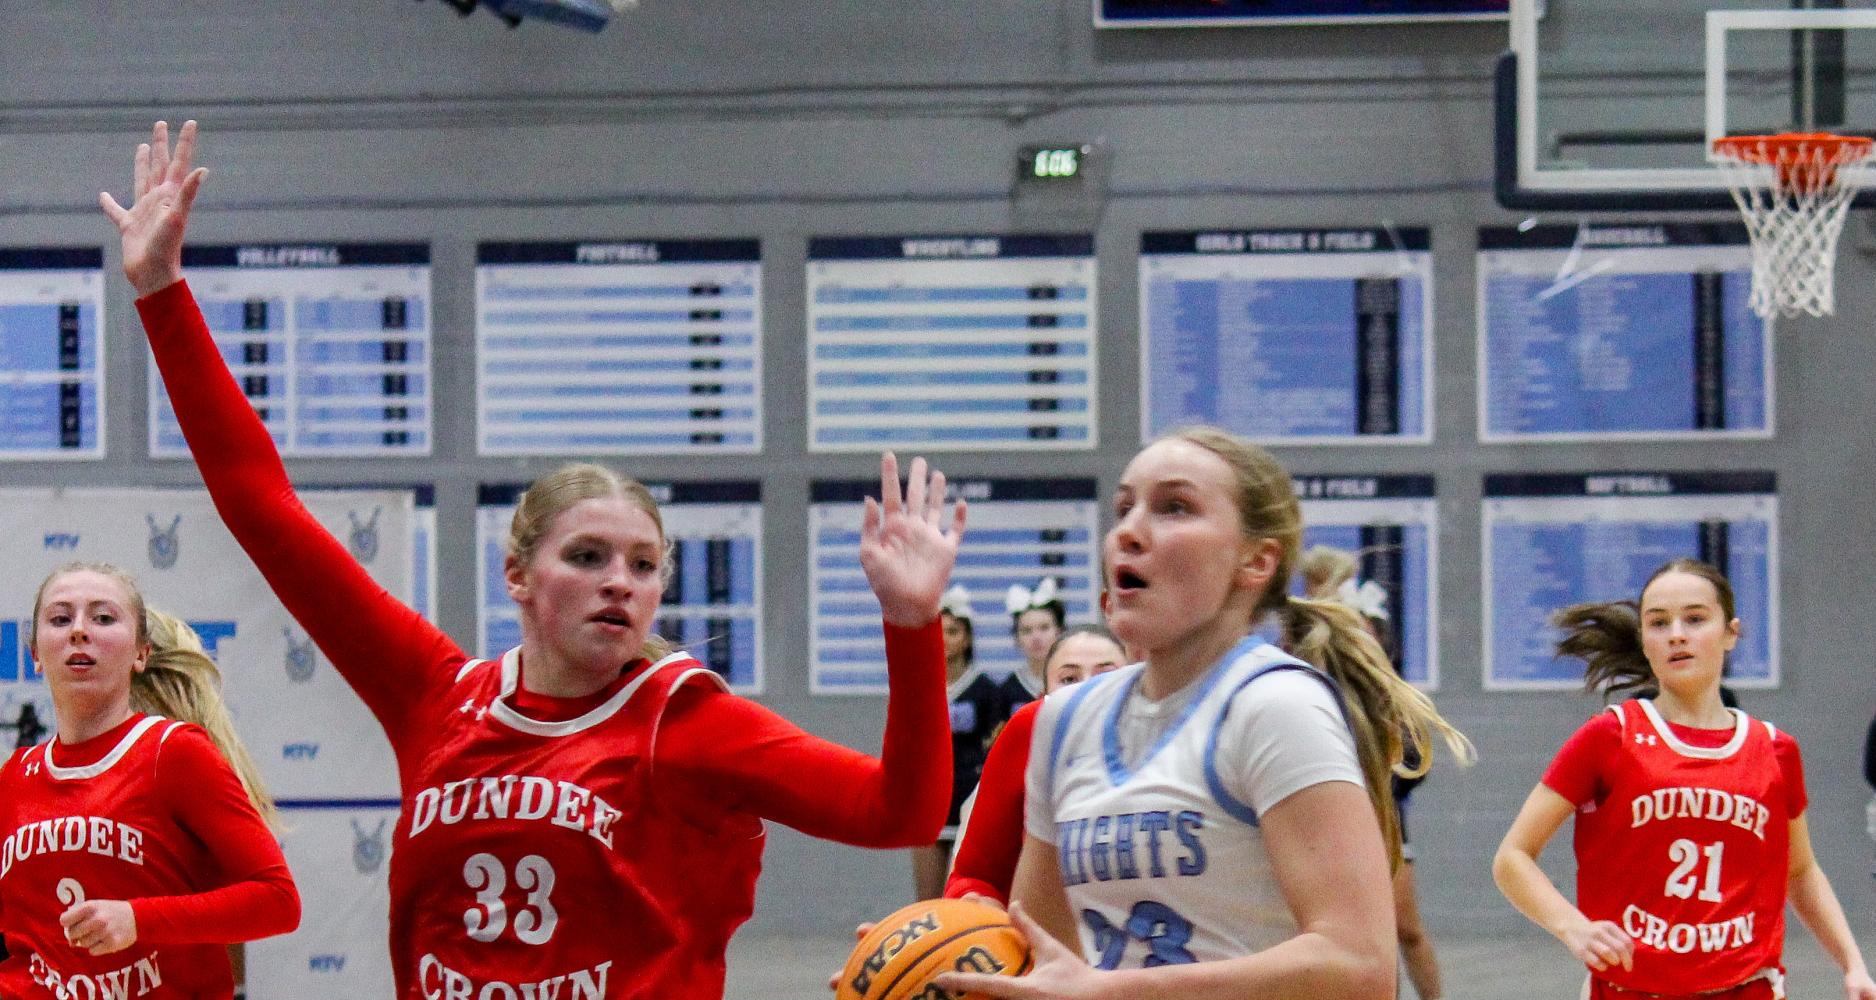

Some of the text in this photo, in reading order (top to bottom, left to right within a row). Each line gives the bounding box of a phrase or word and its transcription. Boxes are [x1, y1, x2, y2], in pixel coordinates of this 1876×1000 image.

[409, 774, 623, 850] DUNDEE
[0, 815, 144, 880] DUNDEE
[1664, 838, 1724, 903] 21
[463, 853, 558, 945] 33
[1622, 904, 1755, 954] CROWN
[852, 912, 940, 996] NCAA
